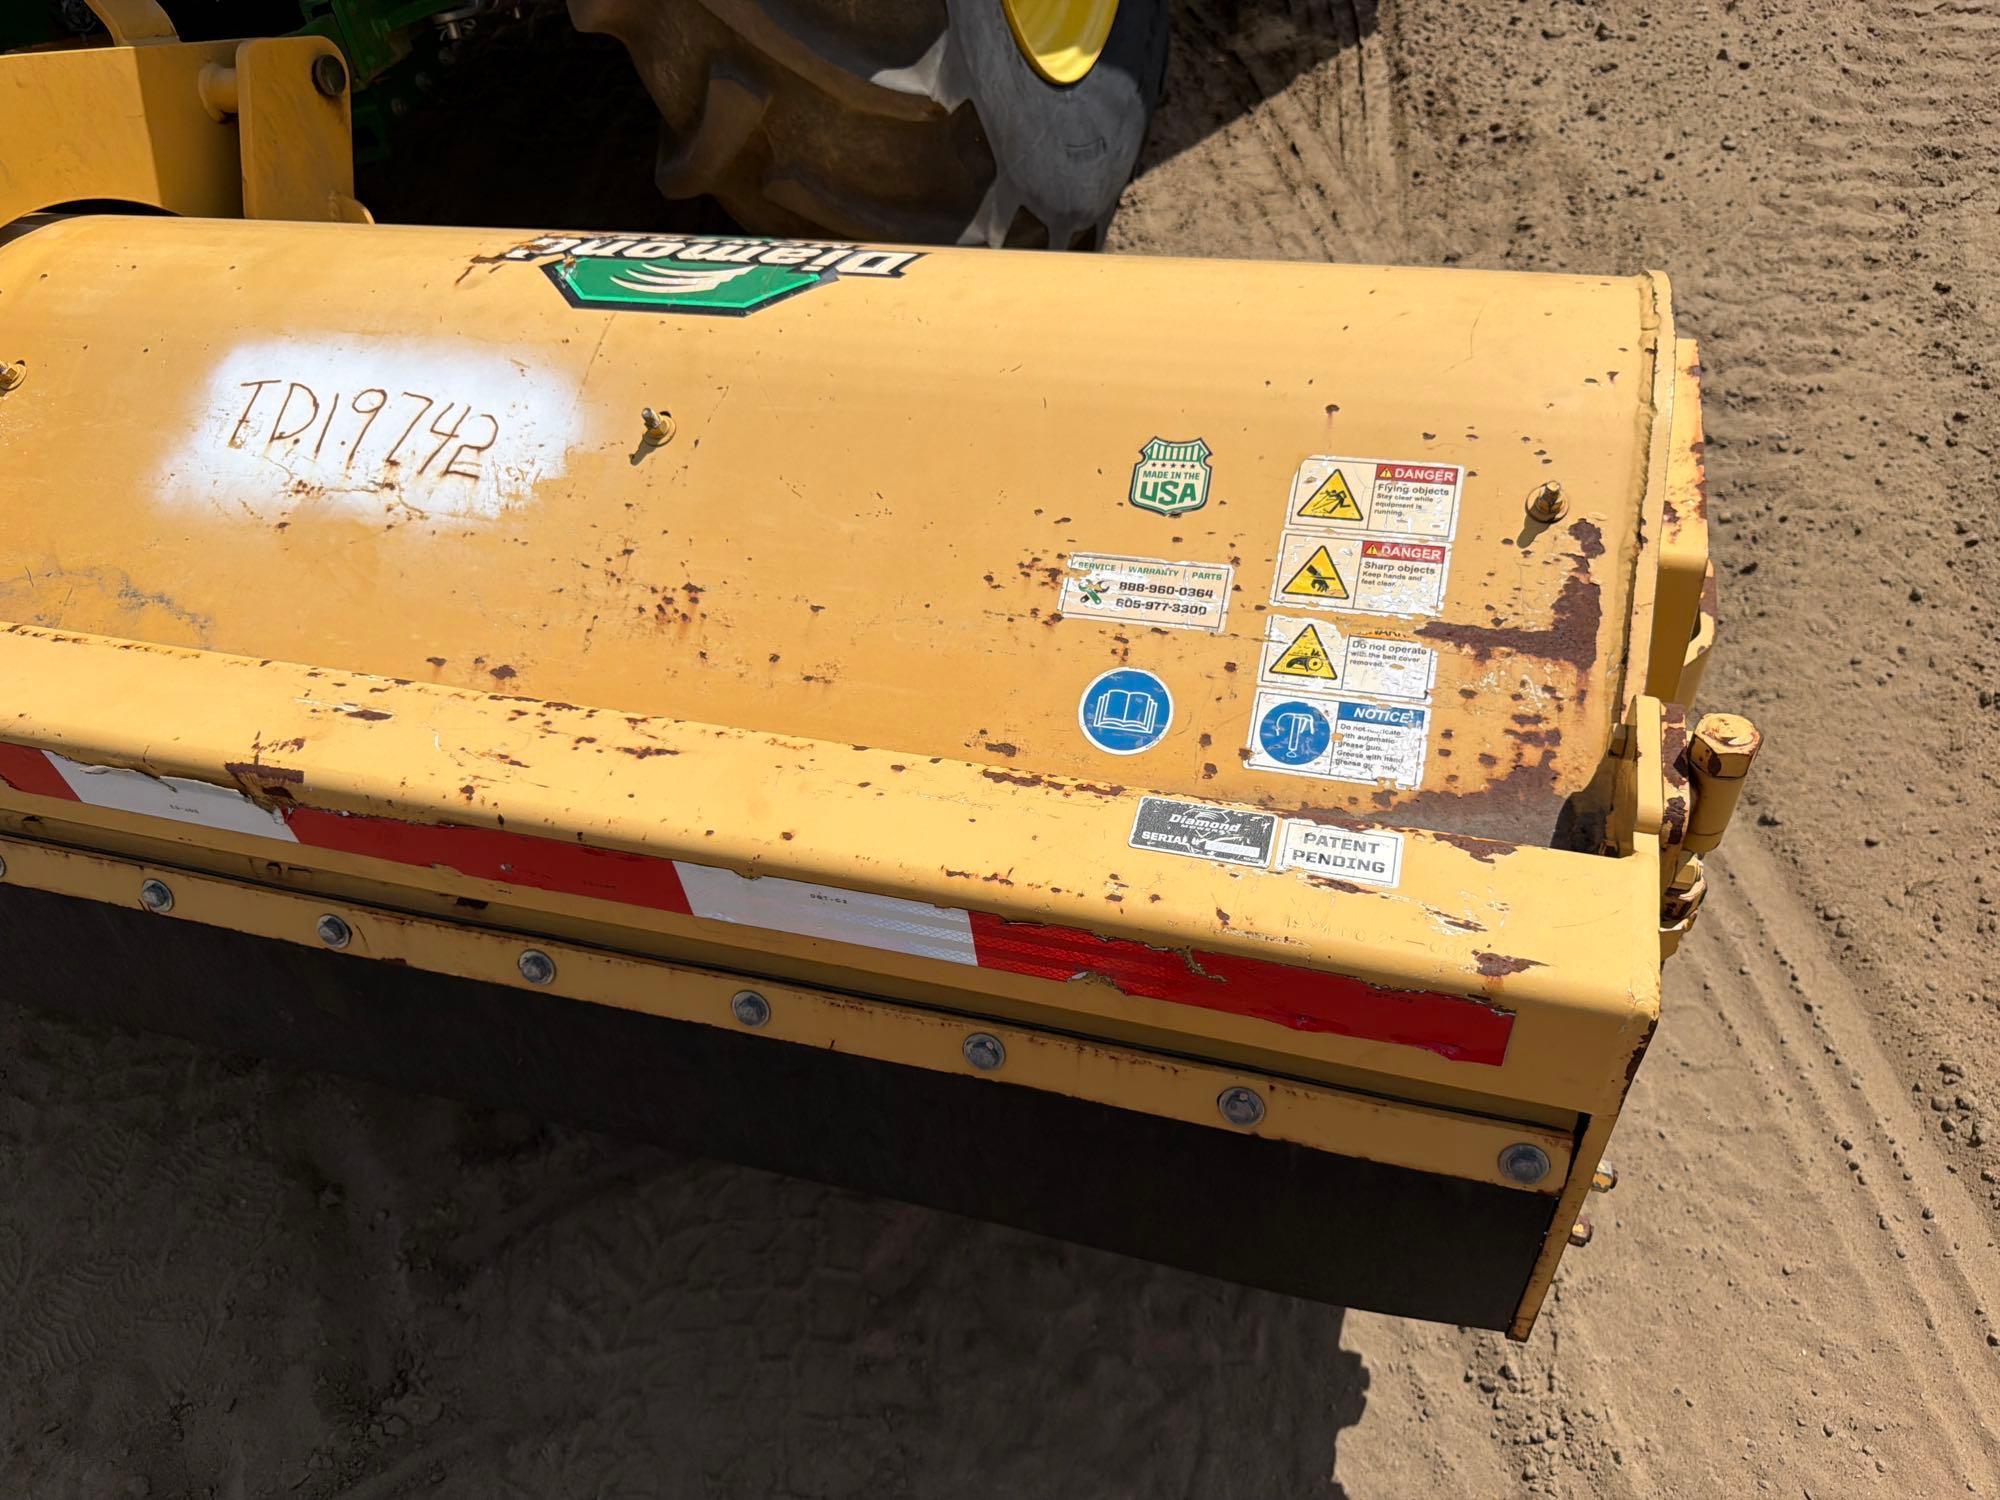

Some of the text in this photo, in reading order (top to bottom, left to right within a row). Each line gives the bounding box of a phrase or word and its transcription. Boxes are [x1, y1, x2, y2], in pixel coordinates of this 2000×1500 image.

[228, 379, 499, 480] TD19742
[1142, 470, 1169, 479] MADE
[1171, 472, 1181, 480] IN
[1395, 468, 1454, 482] DANGER
[1139, 480, 1197, 506] USA
[1378, 484, 1449, 496] Flying objects
[1375, 502, 1414, 510] equipment
[1381, 545, 1441, 560] DANGER
[1078, 561, 1116, 572] SERVICE
[1128, 566, 1179, 577] WARRANTY
[1364, 561, 1435, 574] Sharp objects
[1191, 571, 1222, 581] PARTS
[1362, 571, 1381, 579] Keep
[1383, 572, 1406, 580] hands
[1118, 581, 1214, 599] 888-960-0364
[1115, 597, 1208, 616] 605-977-3300
[1352, 640, 1427, 655] Do not operate
[1382, 653, 1396, 661] belt
[1353, 707, 1411, 724] NOTICE
[1340, 723, 1351, 731] Do
[1342, 732, 1355, 740] ith
[1169, 813, 1242, 833] Diamond
[1141, 831, 1188, 846] SERIAL
[1304, 832, 1380, 854] PATENT
[1292, 849, 1386, 873] PENDING
